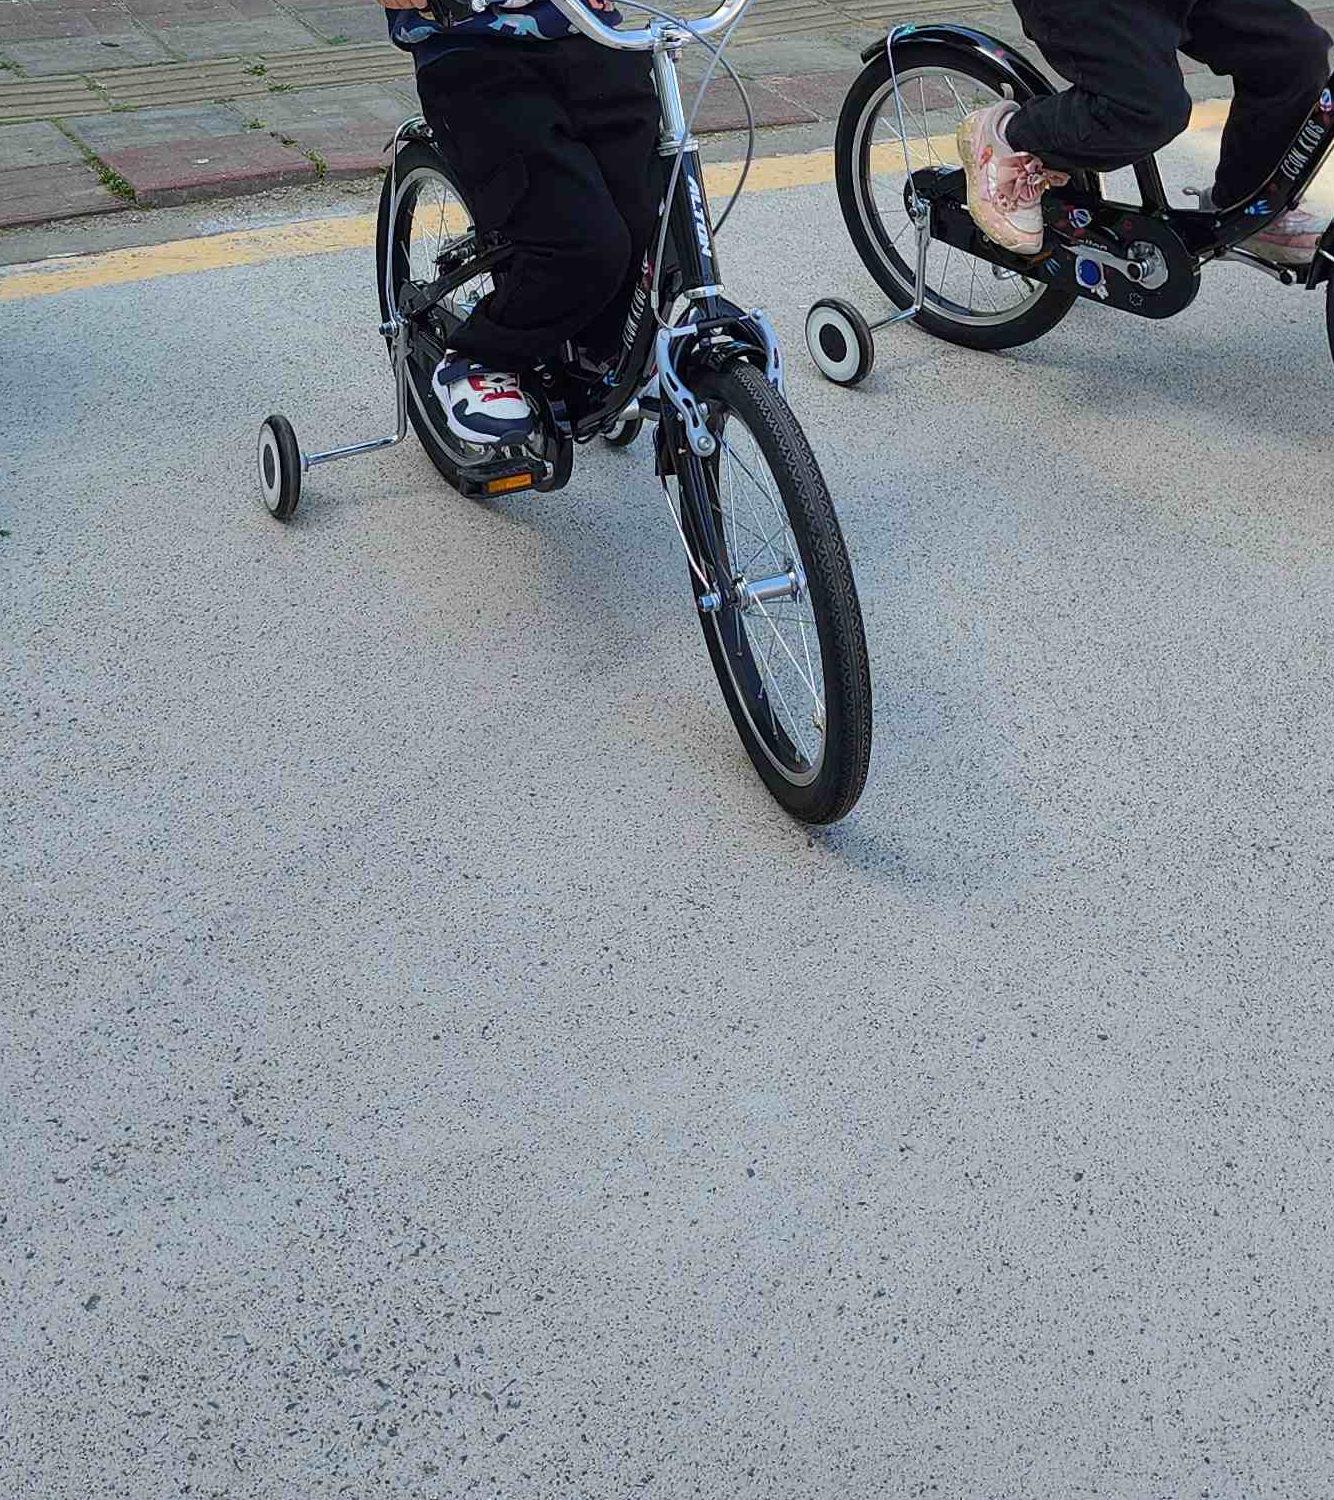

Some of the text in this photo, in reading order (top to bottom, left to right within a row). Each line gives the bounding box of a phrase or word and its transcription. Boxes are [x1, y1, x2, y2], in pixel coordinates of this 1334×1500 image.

[1280, 119, 1324, 181] ICON KIDS
[687, 174, 713, 258] ALTON
